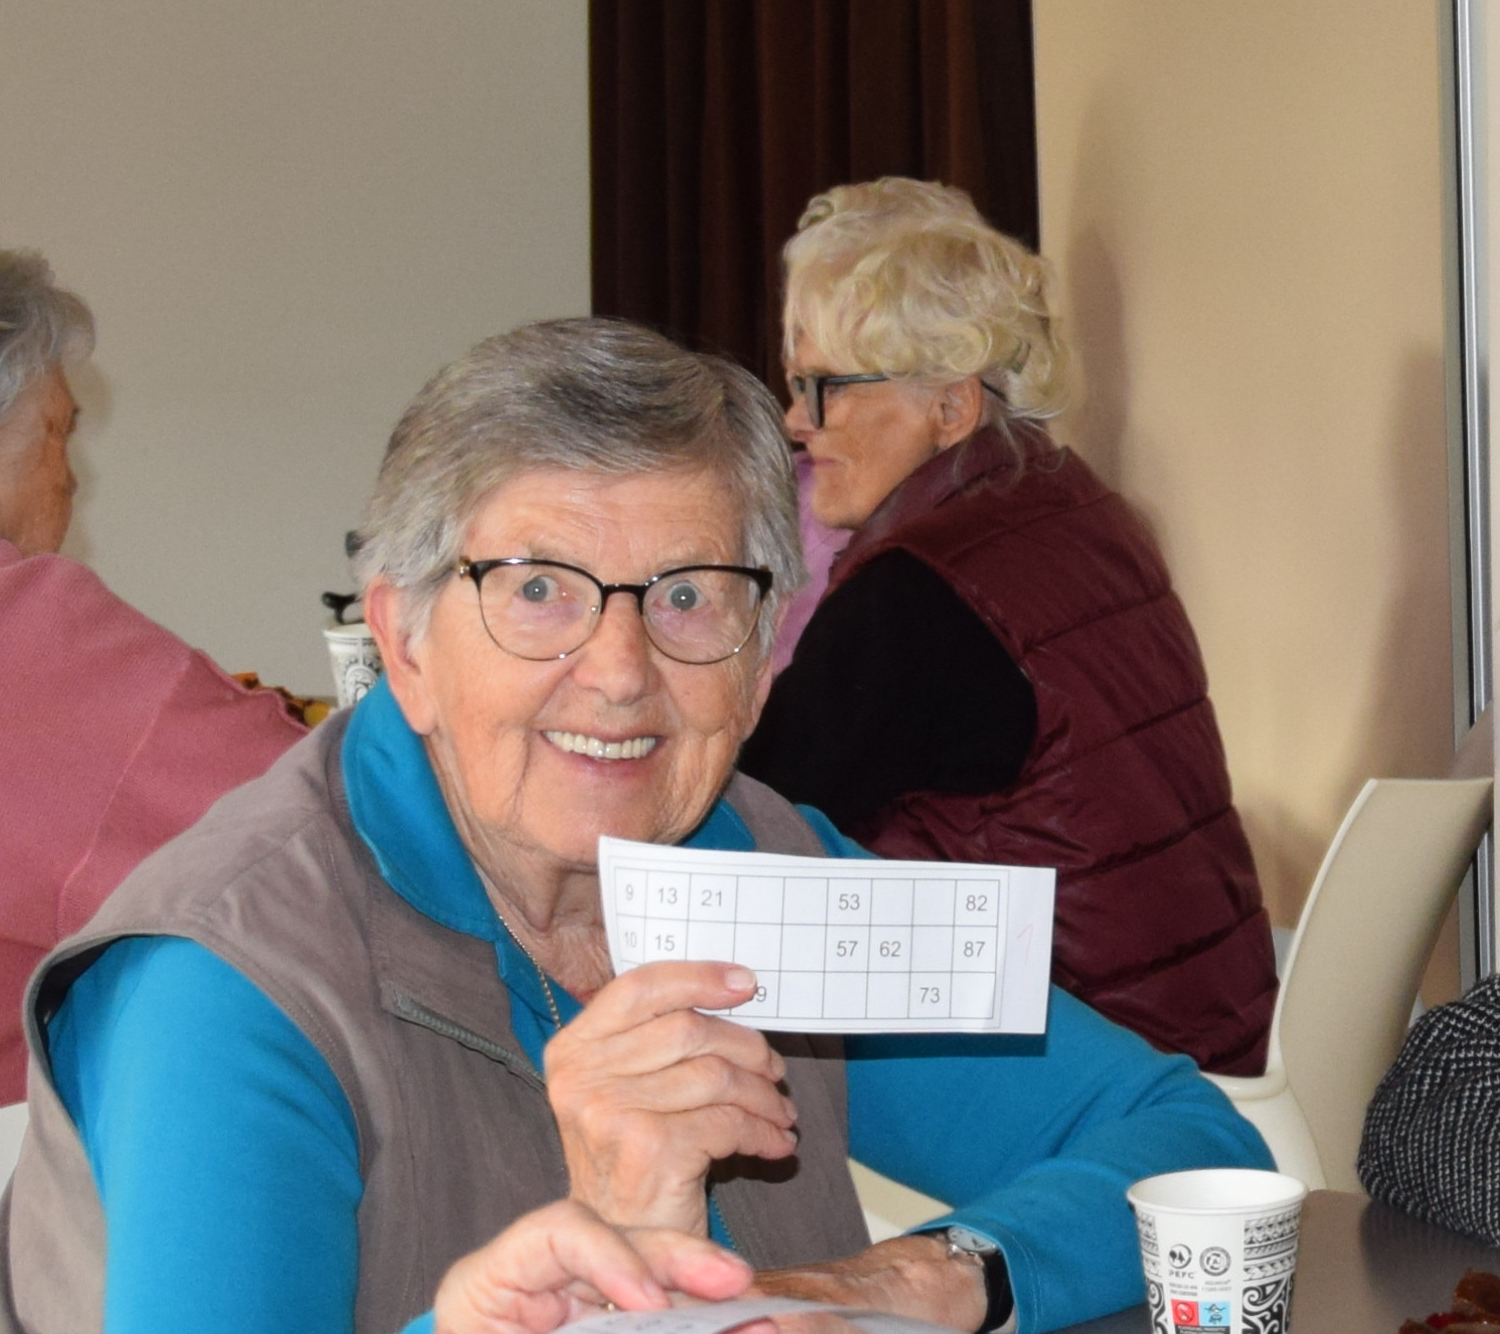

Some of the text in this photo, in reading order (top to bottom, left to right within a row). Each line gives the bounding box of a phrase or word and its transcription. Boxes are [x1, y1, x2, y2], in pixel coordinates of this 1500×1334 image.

[625, 883, 988, 912] 9 13 21 53 82
[624, 931, 986, 958] 10 15 57 62 87
[755, 985, 941, 1004] 9 73
